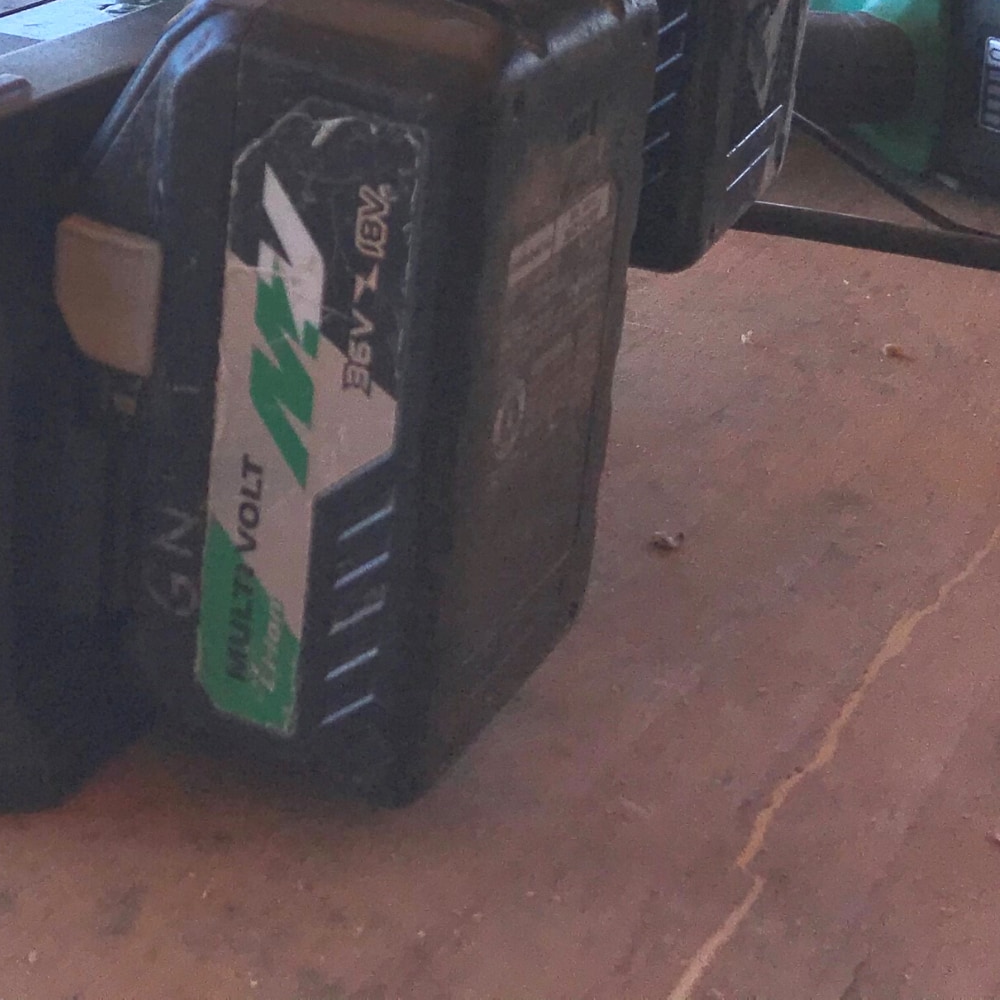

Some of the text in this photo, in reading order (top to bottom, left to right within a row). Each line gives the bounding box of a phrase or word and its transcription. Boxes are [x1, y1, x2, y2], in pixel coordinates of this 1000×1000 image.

[342, 184, 391, 397] 36V 18V
[226, 453, 264, 682] MULTI VOLT
